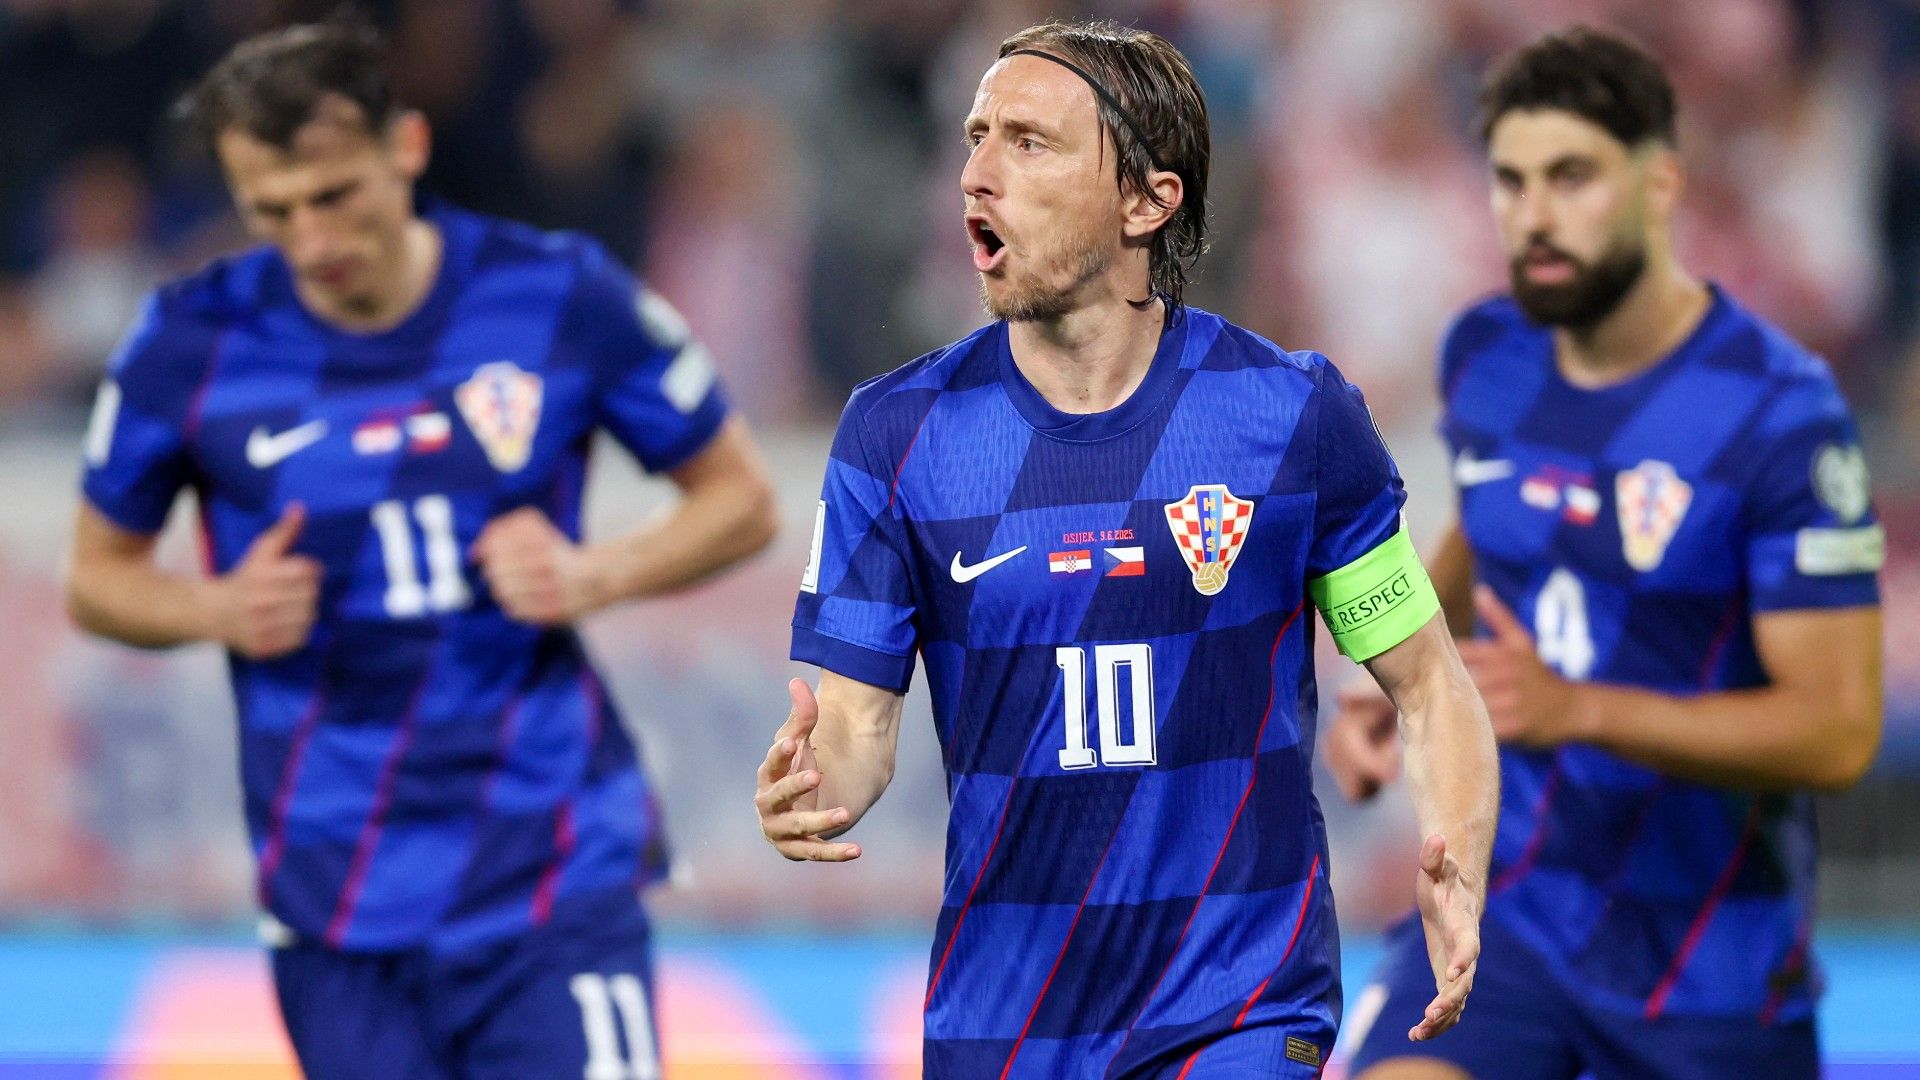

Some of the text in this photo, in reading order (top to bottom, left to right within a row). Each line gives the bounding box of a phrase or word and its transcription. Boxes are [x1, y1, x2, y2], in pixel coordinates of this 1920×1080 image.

[369, 495, 473, 616] 11
[1338, 573, 1410, 627] RESPECT
[1535, 567, 1594, 680] 4
[1056, 643, 1157, 770] 10
[569, 973, 661, 1080] 11
